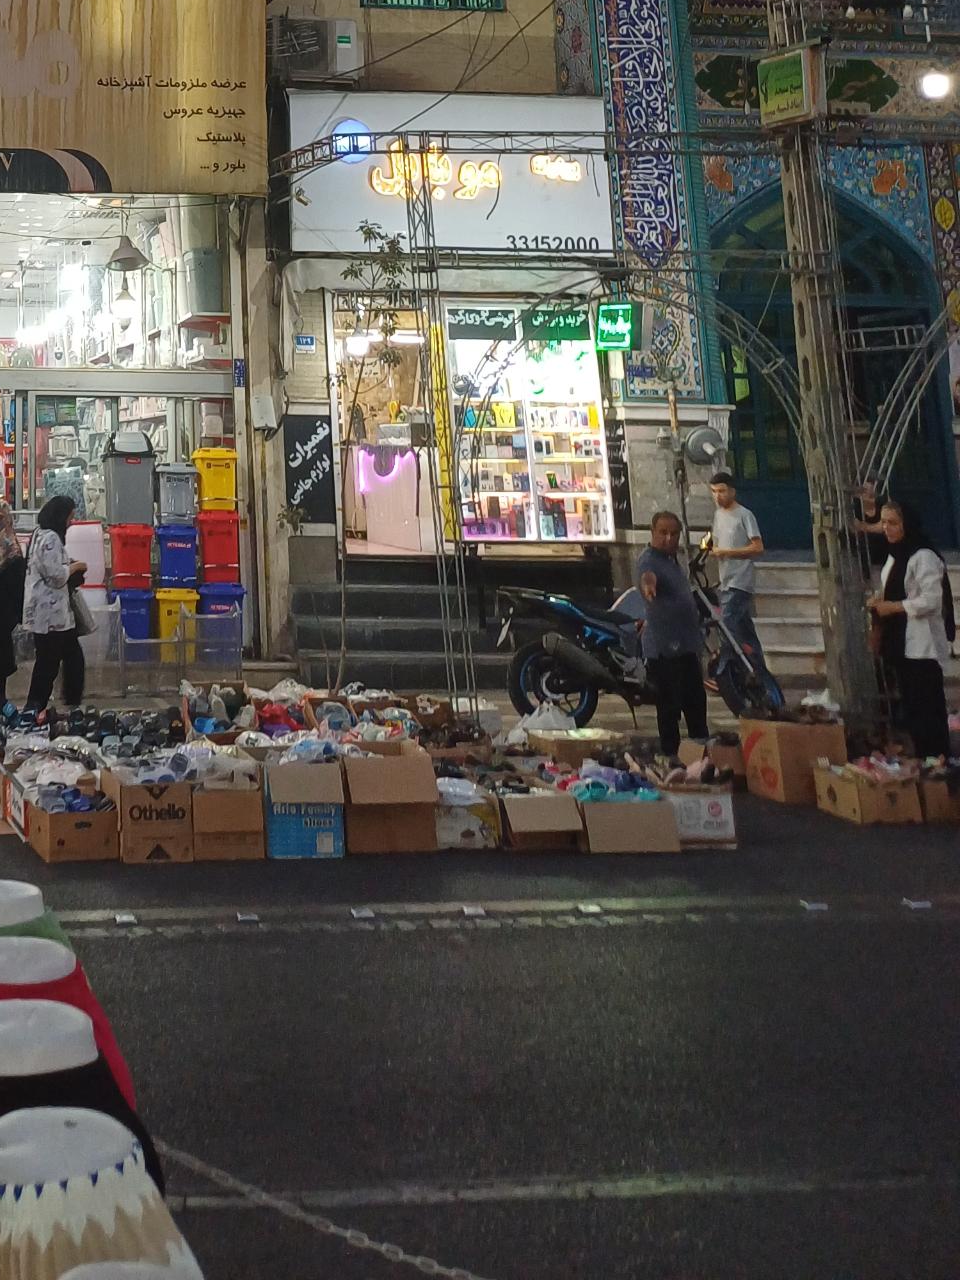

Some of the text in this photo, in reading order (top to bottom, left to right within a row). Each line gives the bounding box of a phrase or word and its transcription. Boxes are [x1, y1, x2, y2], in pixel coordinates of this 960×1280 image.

[96, 75, 247, 92] عرضه ملزومات آشپزخانه
[163, 106, 246, 119] جهیزیه عروس
[196, 131, 246, 147] پلاستیک
[213, 163, 220, 173] و
[223, 160, 246, 173] بلور
[371, 138, 502, 200] موبایل
[506, 234, 600, 252] 33152000
[566, 310, 587, 328] خرید
[289, 420, 330, 468] تعمیرات
[290, 453, 331, 505] لوازم جانبی
[129, 803, 186, 822] Othello
